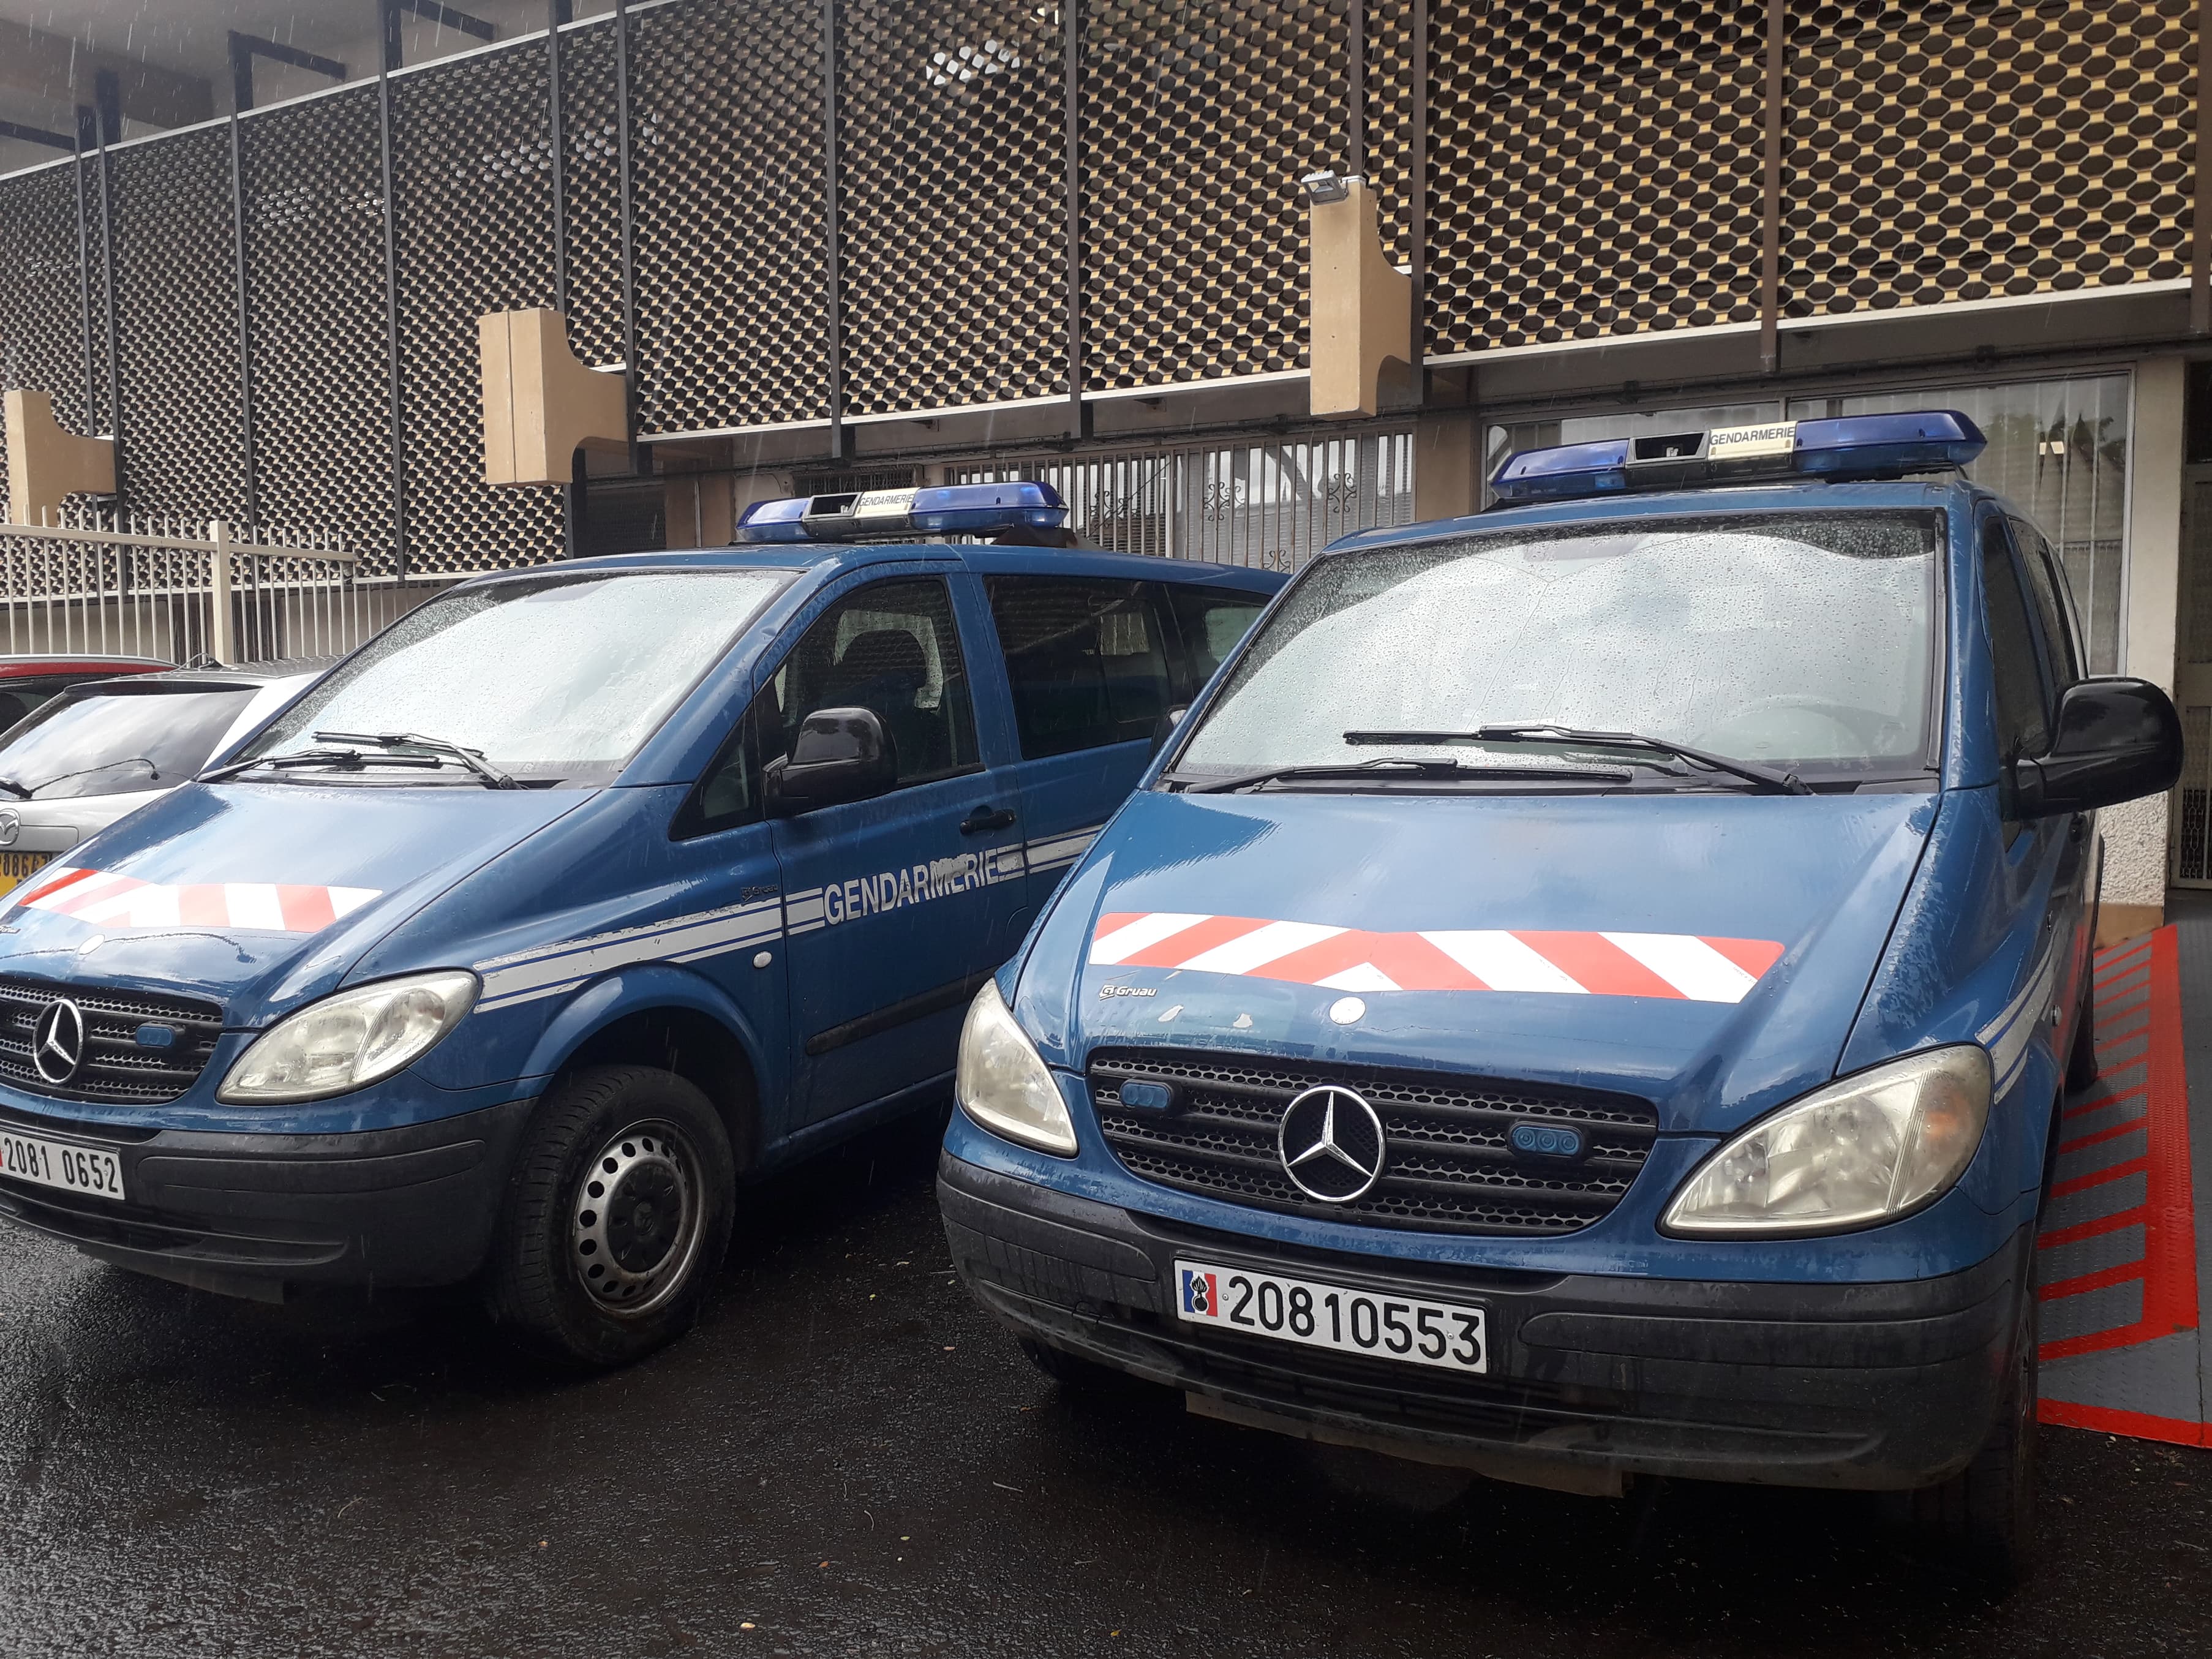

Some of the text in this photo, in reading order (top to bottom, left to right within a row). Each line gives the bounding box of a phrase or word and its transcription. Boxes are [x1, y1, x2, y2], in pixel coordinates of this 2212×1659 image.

[1710, 426, 1795, 446] GENDARMERIE
[859, 494, 916, 506] GENDARMERIE
[824, 848, 999, 925] GENDARMERIE
[1116, 985, 1157, 997] Gruau
[4, 1137, 118, 1193] 2081 0652
[1228, 1276, 1481, 1365] 20810553
